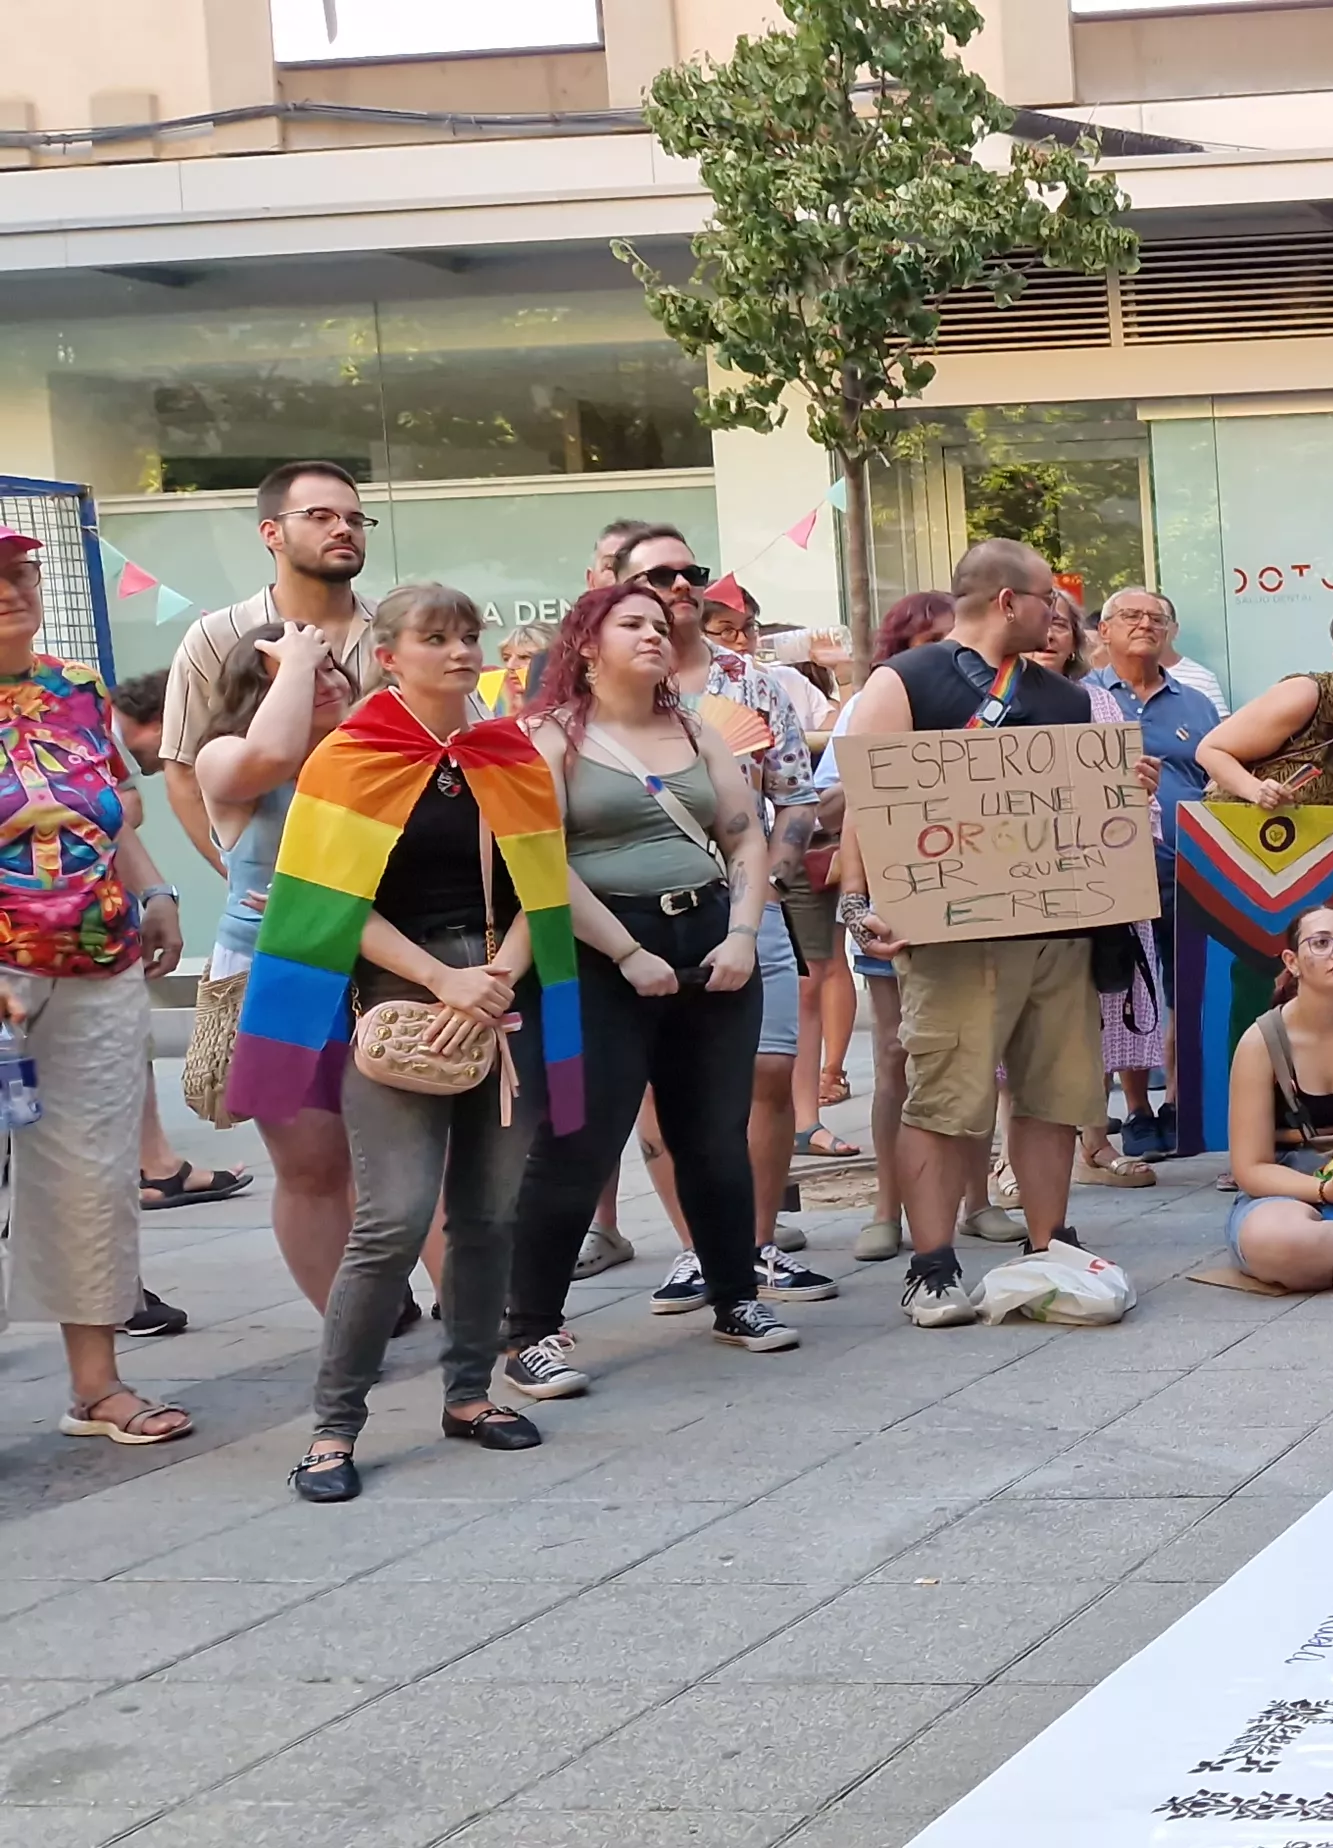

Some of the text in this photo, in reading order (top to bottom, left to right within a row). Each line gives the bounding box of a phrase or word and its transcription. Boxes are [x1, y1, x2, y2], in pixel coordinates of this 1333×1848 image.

[868, 728, 1142, 790] ESPERO QUE
[858, 797, 952, 825] TE
[1103, 785, 1150, 809] DE
[917, 816, 1137, 858] ORGULLO
[882, 859, 978, 903] SER
[945, 881, 1115, 926] ERES
